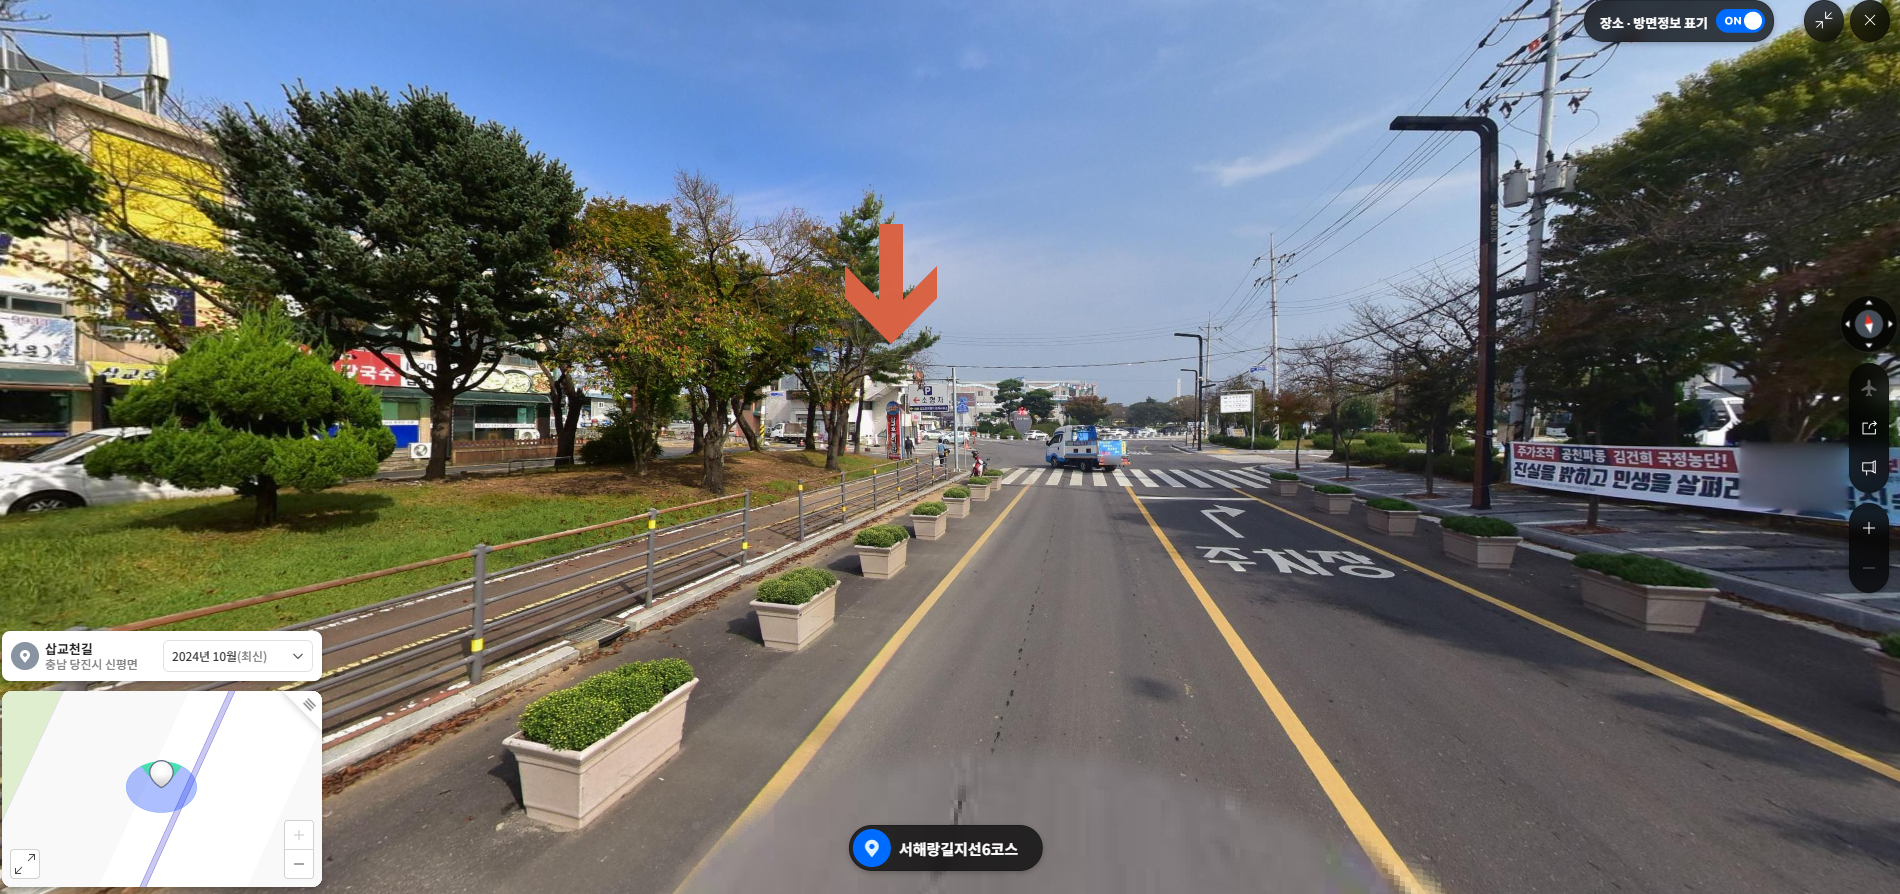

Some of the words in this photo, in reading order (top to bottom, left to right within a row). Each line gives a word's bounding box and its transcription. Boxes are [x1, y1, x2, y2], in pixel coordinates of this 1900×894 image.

[1490, 211, 1498, 243] DANGJIN
[1517, 445, 1555, 460] 주가조작
[1561, 449, 1607, 463] 공천파동
[1613, 449, 1653, 466] 김건희
[1657, 452, 1728, 468] 국정농단!
[1513, 461, 1556, 482] 진실을
[1559, 465, 1608, 488] 밝히고
[1612, 470, 1671, 494] 민생을
[1195, 545, 1396, 579] 주차장
